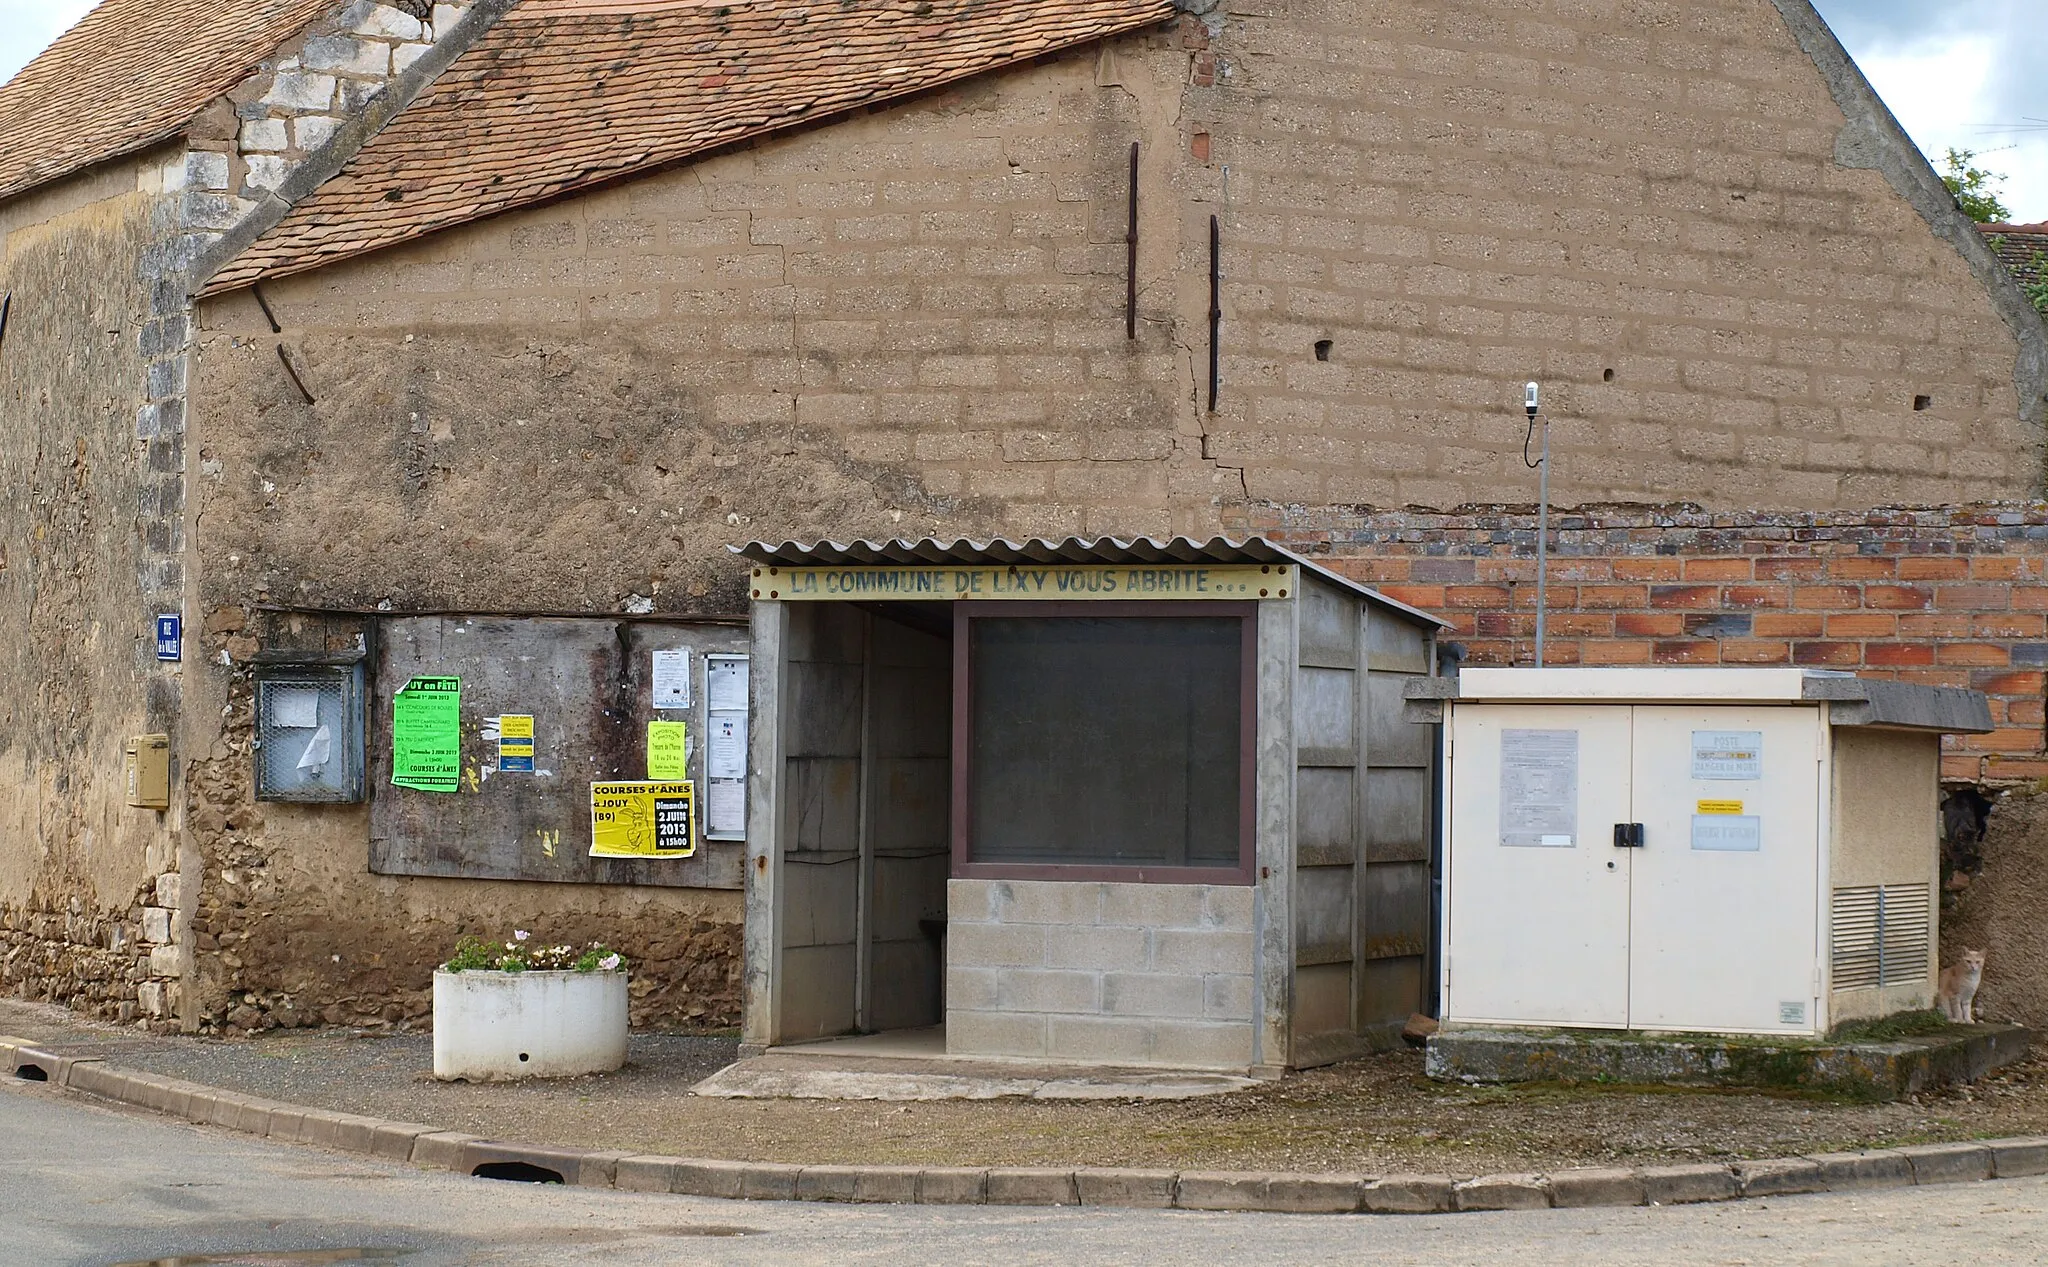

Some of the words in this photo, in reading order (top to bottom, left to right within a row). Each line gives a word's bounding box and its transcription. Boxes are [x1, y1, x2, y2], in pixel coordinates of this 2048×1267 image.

[791, 572, 818, 593] LA
[826, 571, 946, 593] COMMUNE
[955, 571, 984, 592] DE
[993, 570, 1049, 592] LIXY
[1056, 570, 1117, 592] VOUS
[163, 621, 172, 635] RUE
[437, 679, 457, 691] FÊTE
[652, 729, 680, 739] EXPOSITION
[657, 733, 675, 741] PHOTO
[1714, 736, 1739, 746] POSTE
[436, 763, 457, 772] d'ÂNES
[1695, 762, 1725, 772] DANGER
[395, 776, 430, 784] ATTRACTIONS
[594, 786, 646, 795] COURSES
[648, 784, 690, 794] d'ÂNES
[594, 799, 600, 807] à
[602, 800, 628, 808] JOUY
[656, 800, 688, 810] Dimanche
[595, 812, 615, 822] (89)
[658, 812, 666, 822] 2
[666, 812, 686, 822] JUIN
[660, 823, 686, 836] 2013
[659, 837, 665, 846] à
[666, 837, 687, 846] 15h00
